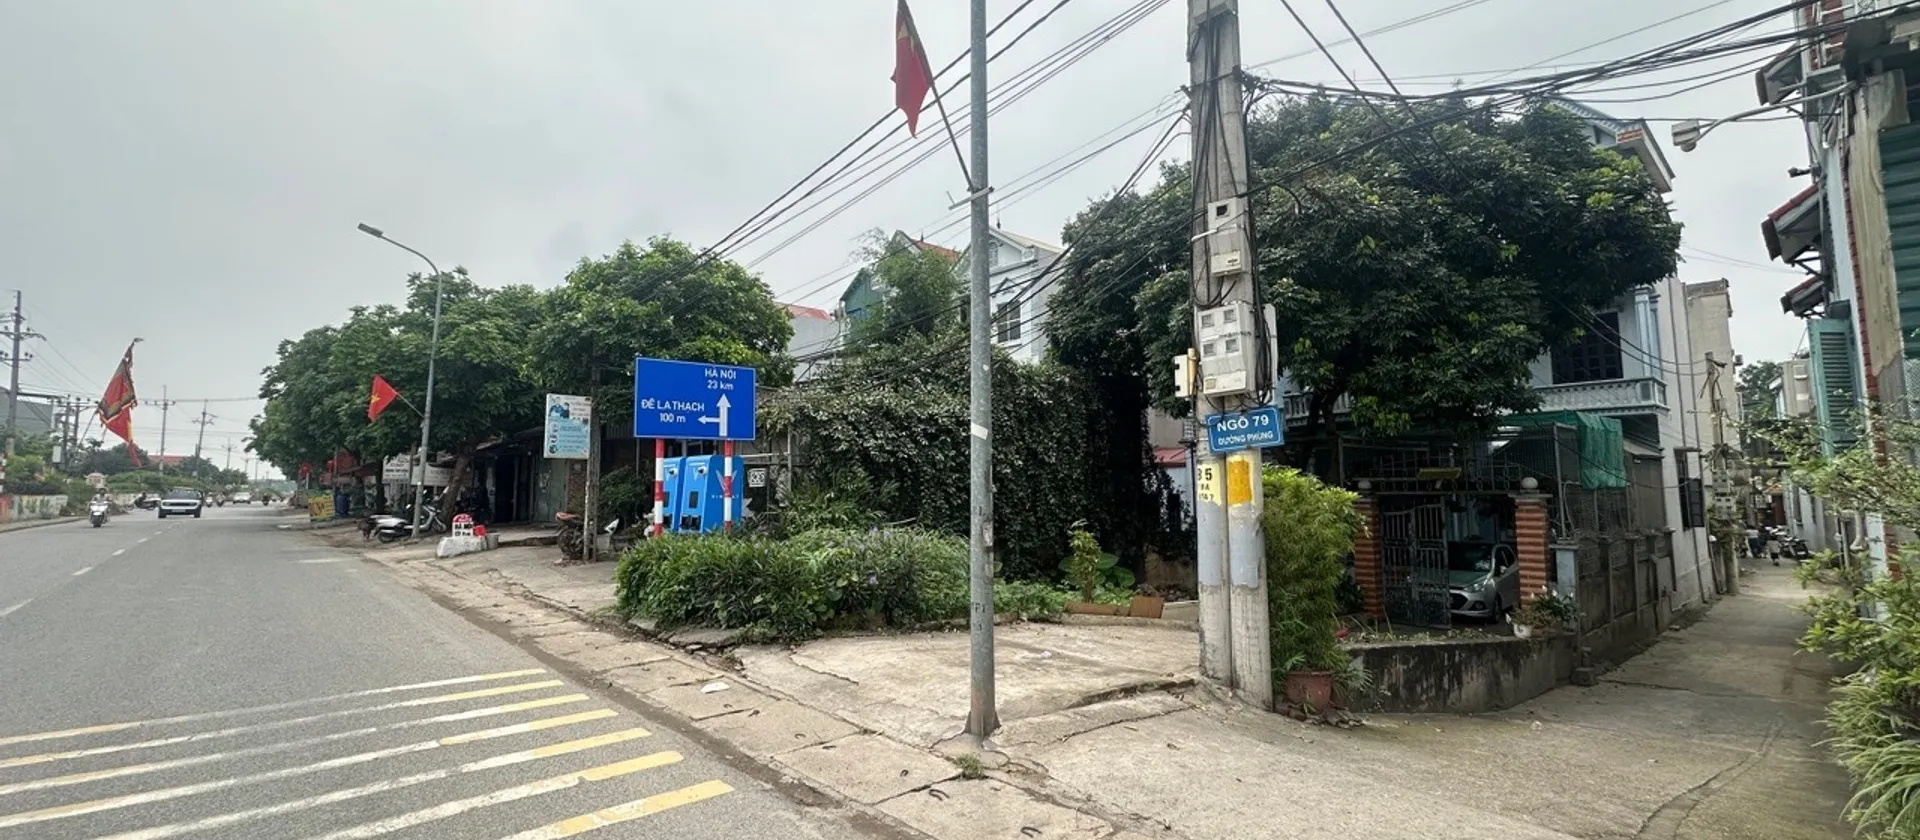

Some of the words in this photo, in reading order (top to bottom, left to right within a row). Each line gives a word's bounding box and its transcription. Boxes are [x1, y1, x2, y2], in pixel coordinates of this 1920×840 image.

[707, 379, 718, 390] 23
[720, 380, 734, 391] km
[660, 412, 675, 423] 100
[676, 415, 686, 423] m
[1252, 414, 1269, 427] 79
